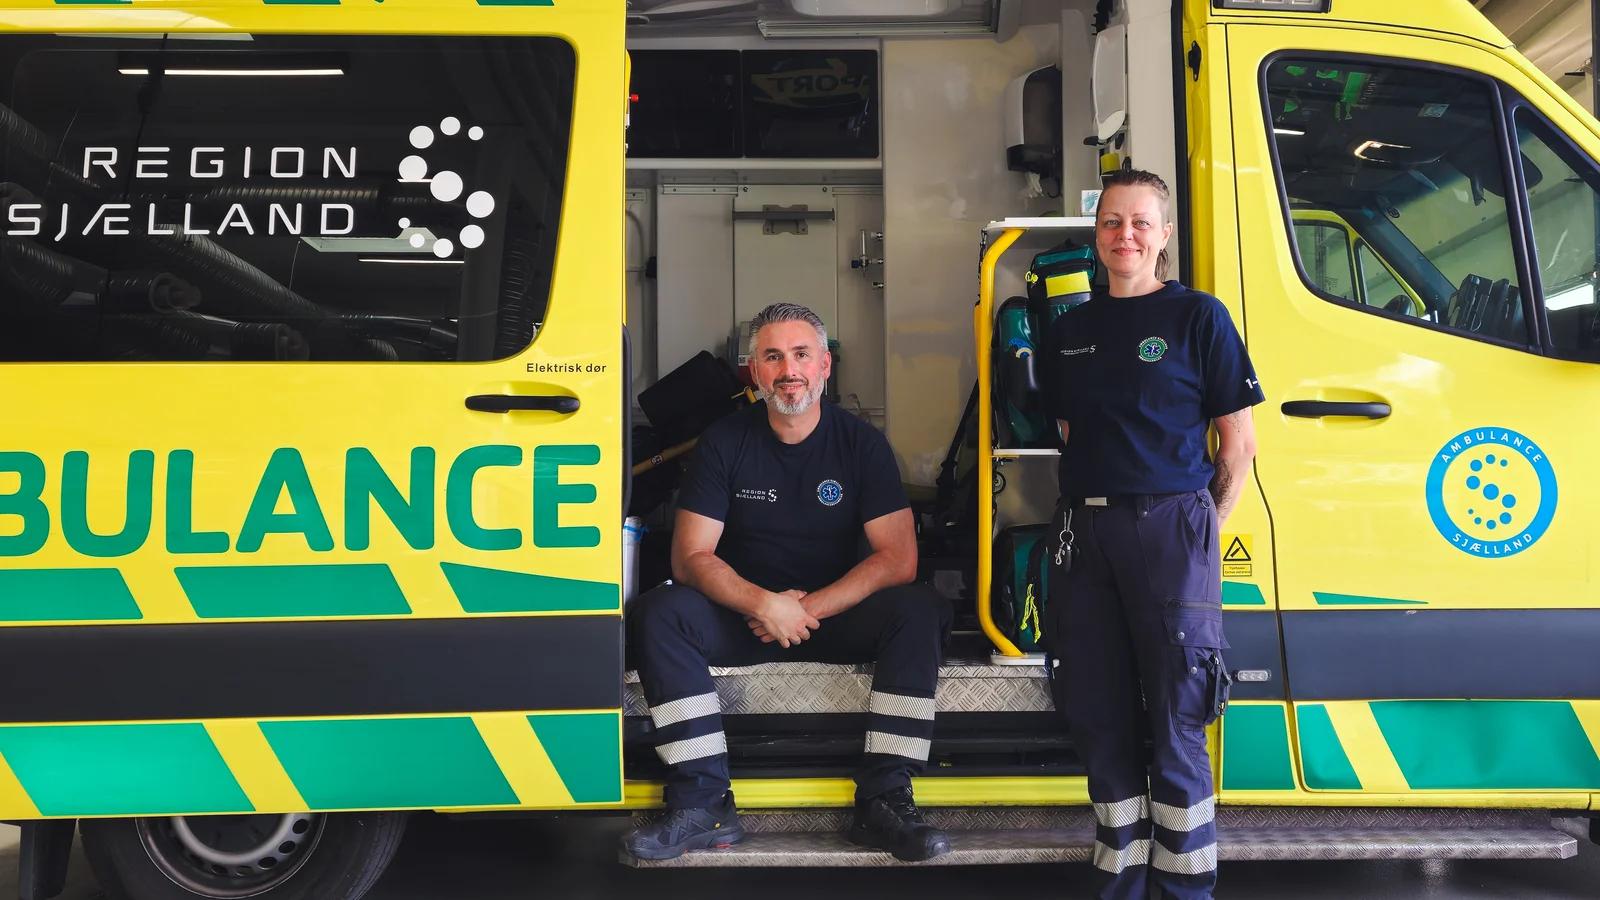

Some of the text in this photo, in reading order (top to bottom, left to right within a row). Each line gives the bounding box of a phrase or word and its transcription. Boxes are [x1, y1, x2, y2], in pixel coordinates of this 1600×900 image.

[83, 147, 356, 178] REGION
[7, 203, 354, 241] SJÆLLAND
[526, 363, 607, 373] Elektrisk dør
[1441, 431, 1542, 463] AMBULANCE
[0, 444, 601, 557] BULANCE
[1453, 533, 1532, 554] SJÆLLAND
